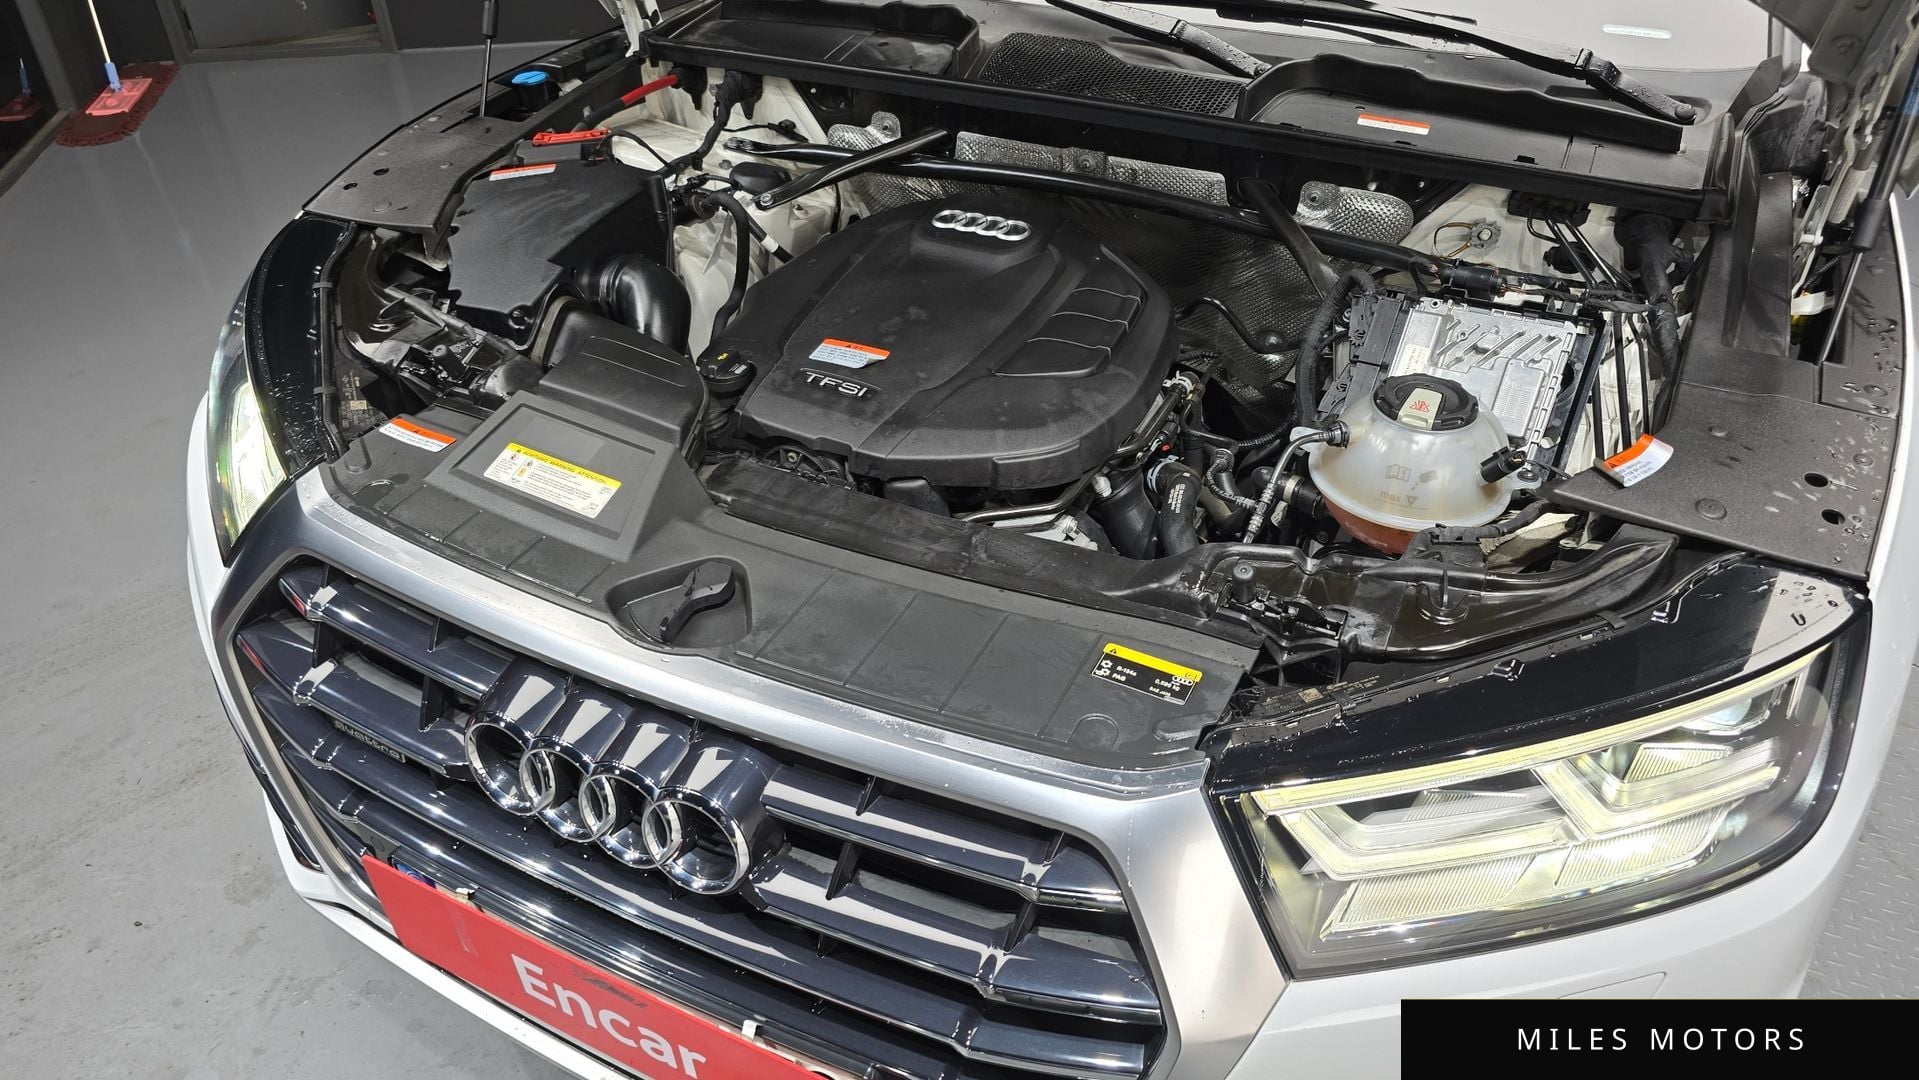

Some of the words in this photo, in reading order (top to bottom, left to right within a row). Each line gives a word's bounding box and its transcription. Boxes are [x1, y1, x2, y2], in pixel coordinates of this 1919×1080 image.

[806, 371, 868, 397] TFSI
[523, 450, 548, 463] ACHTUNG
[549, 460, 575, 473] WARNING
[577, 470, 606, 484] ATTENTION
[1380, 490, 1401, 503] max
[510, 953, 707, 1079] Encar
